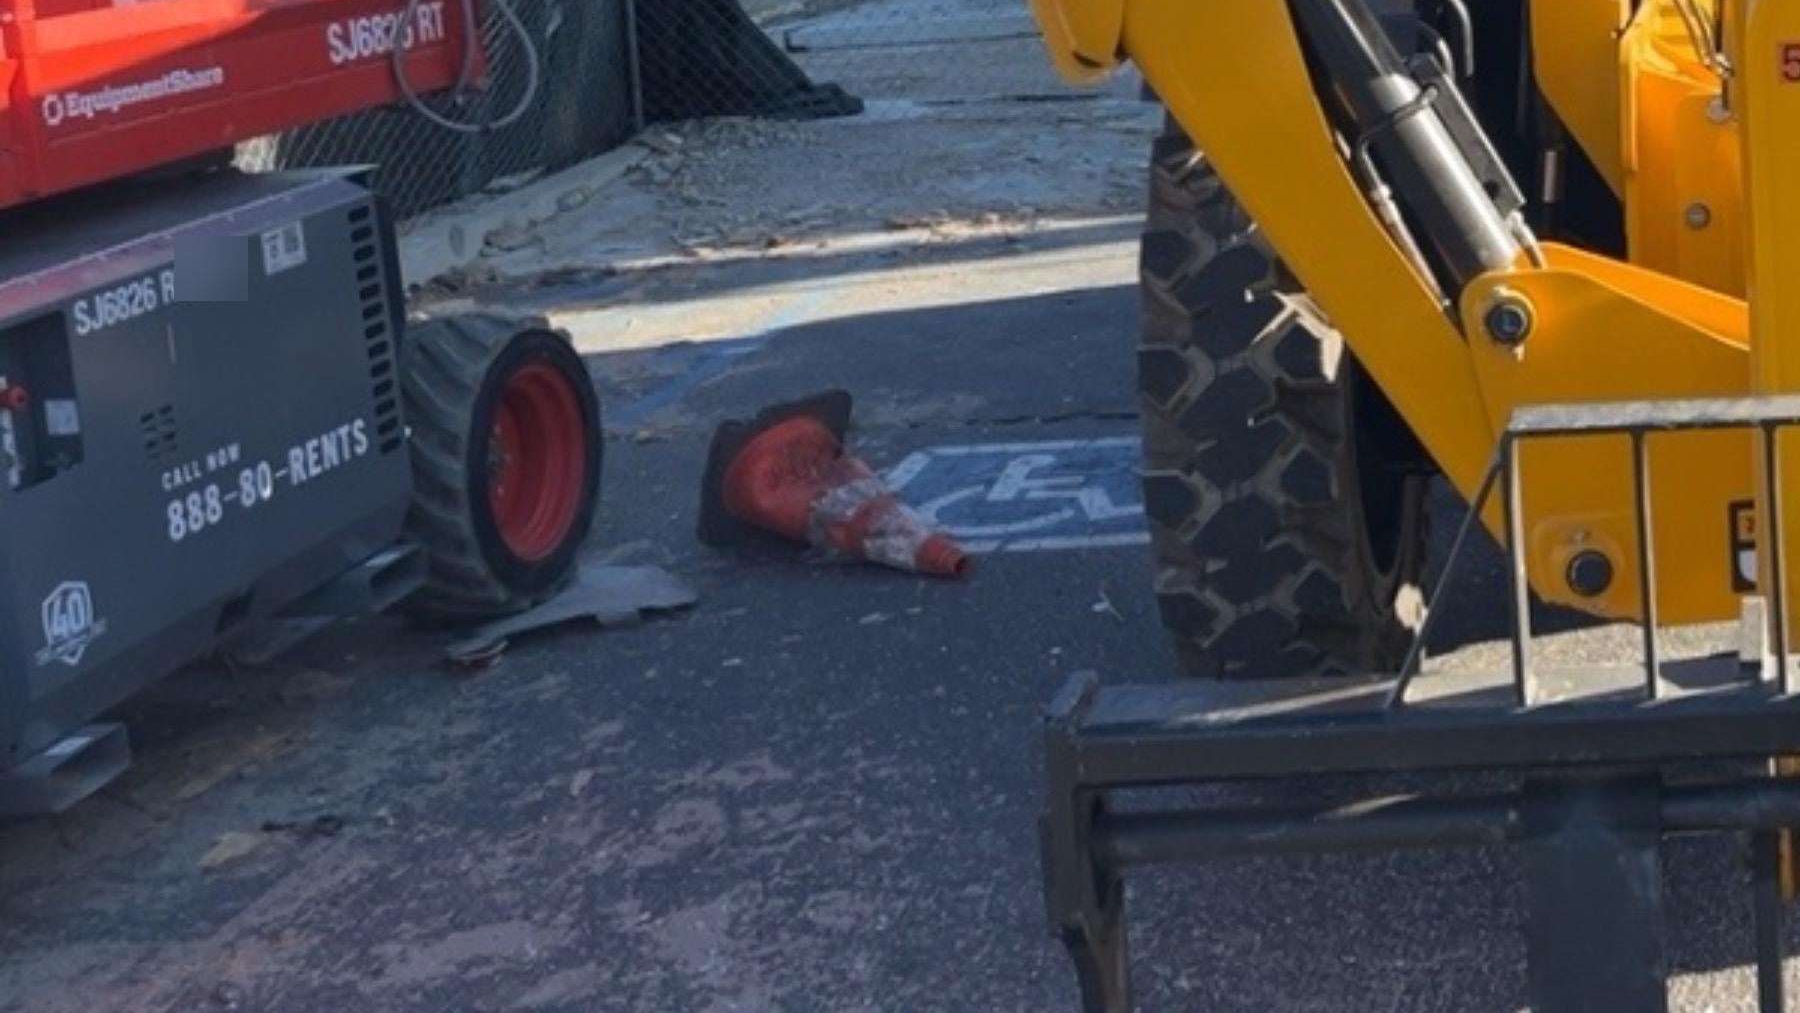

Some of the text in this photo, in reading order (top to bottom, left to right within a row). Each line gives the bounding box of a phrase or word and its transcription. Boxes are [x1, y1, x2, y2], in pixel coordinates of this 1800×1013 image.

[416, 0, 444, 42] RT
[73, 277, 158, 336] SJ6826
[161, 442, 241, 491] CALL NOW
[166, 418, 369, 542] 888-80-RENTS
